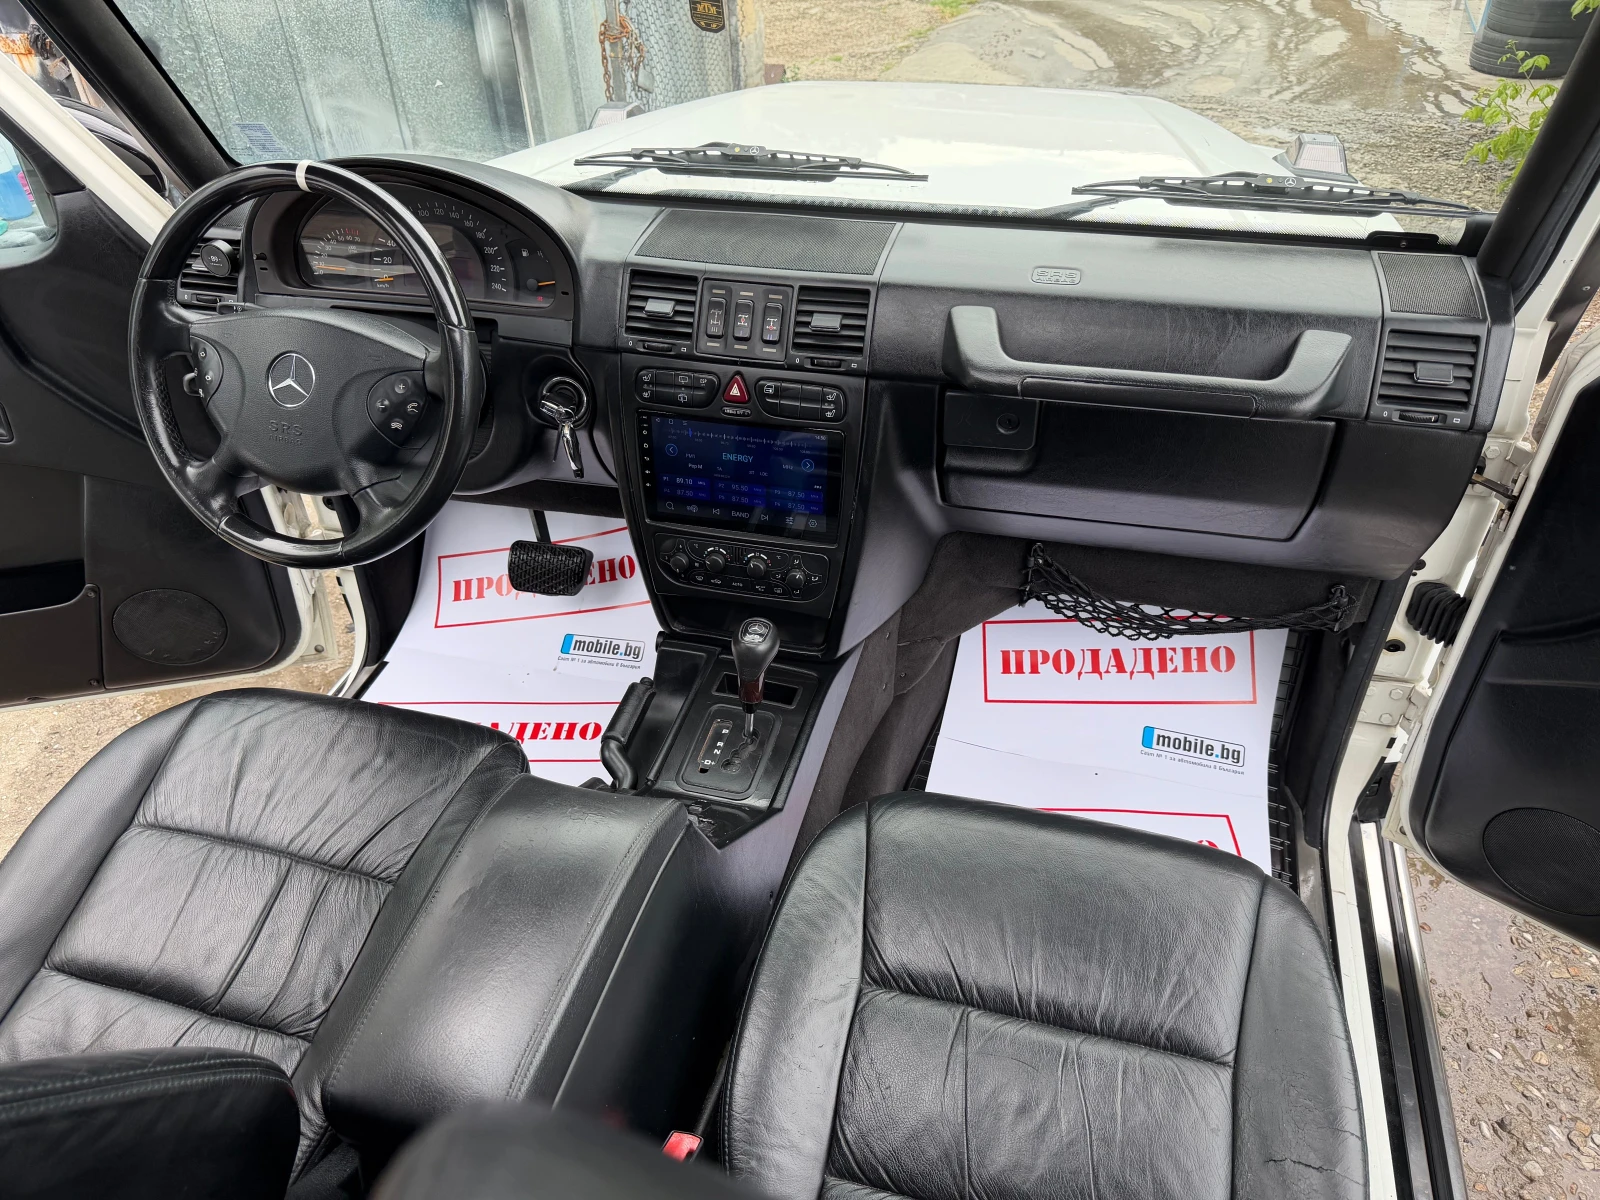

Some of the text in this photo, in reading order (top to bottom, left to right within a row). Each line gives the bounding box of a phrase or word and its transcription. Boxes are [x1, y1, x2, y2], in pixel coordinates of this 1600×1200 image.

[1036, 270, 1077, 278] SRS
[269, 420, 302, 436] SRS
[722, 452, 754, 463] ENERGY
[731, 510, 750, 519] BAND
[452, 554, 636, 602] ПРОЕНО
[572, 639, 642, 660] mobile.bg
[1000, 646, 1236, 680] ПРОДАДЕНО
[1156, 733, 1241, 764] mobile.bg
